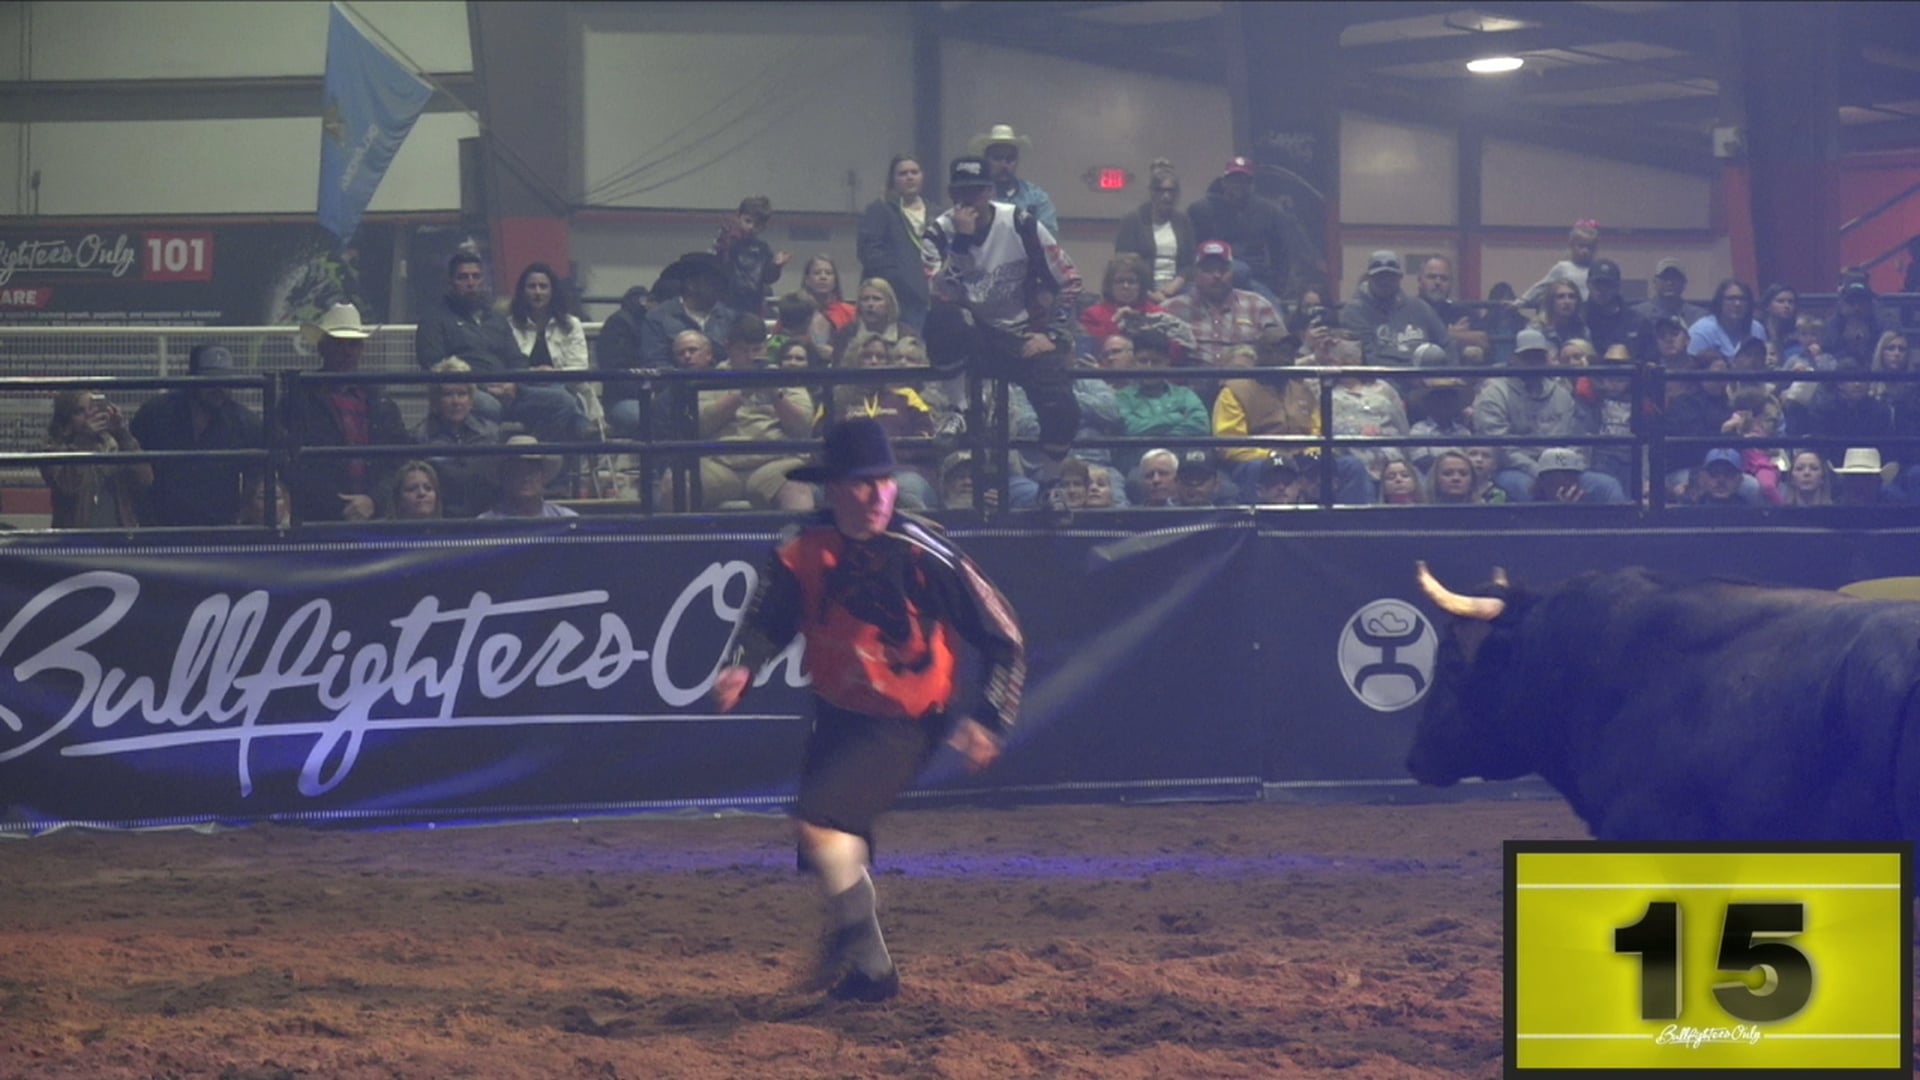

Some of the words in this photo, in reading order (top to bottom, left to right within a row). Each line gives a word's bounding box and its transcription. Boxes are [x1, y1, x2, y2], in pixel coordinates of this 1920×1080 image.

[76, 234, 135, 277] Only
[148, 238, 204, 272] 101
[0, 570, 648, 797] Bullfighters
